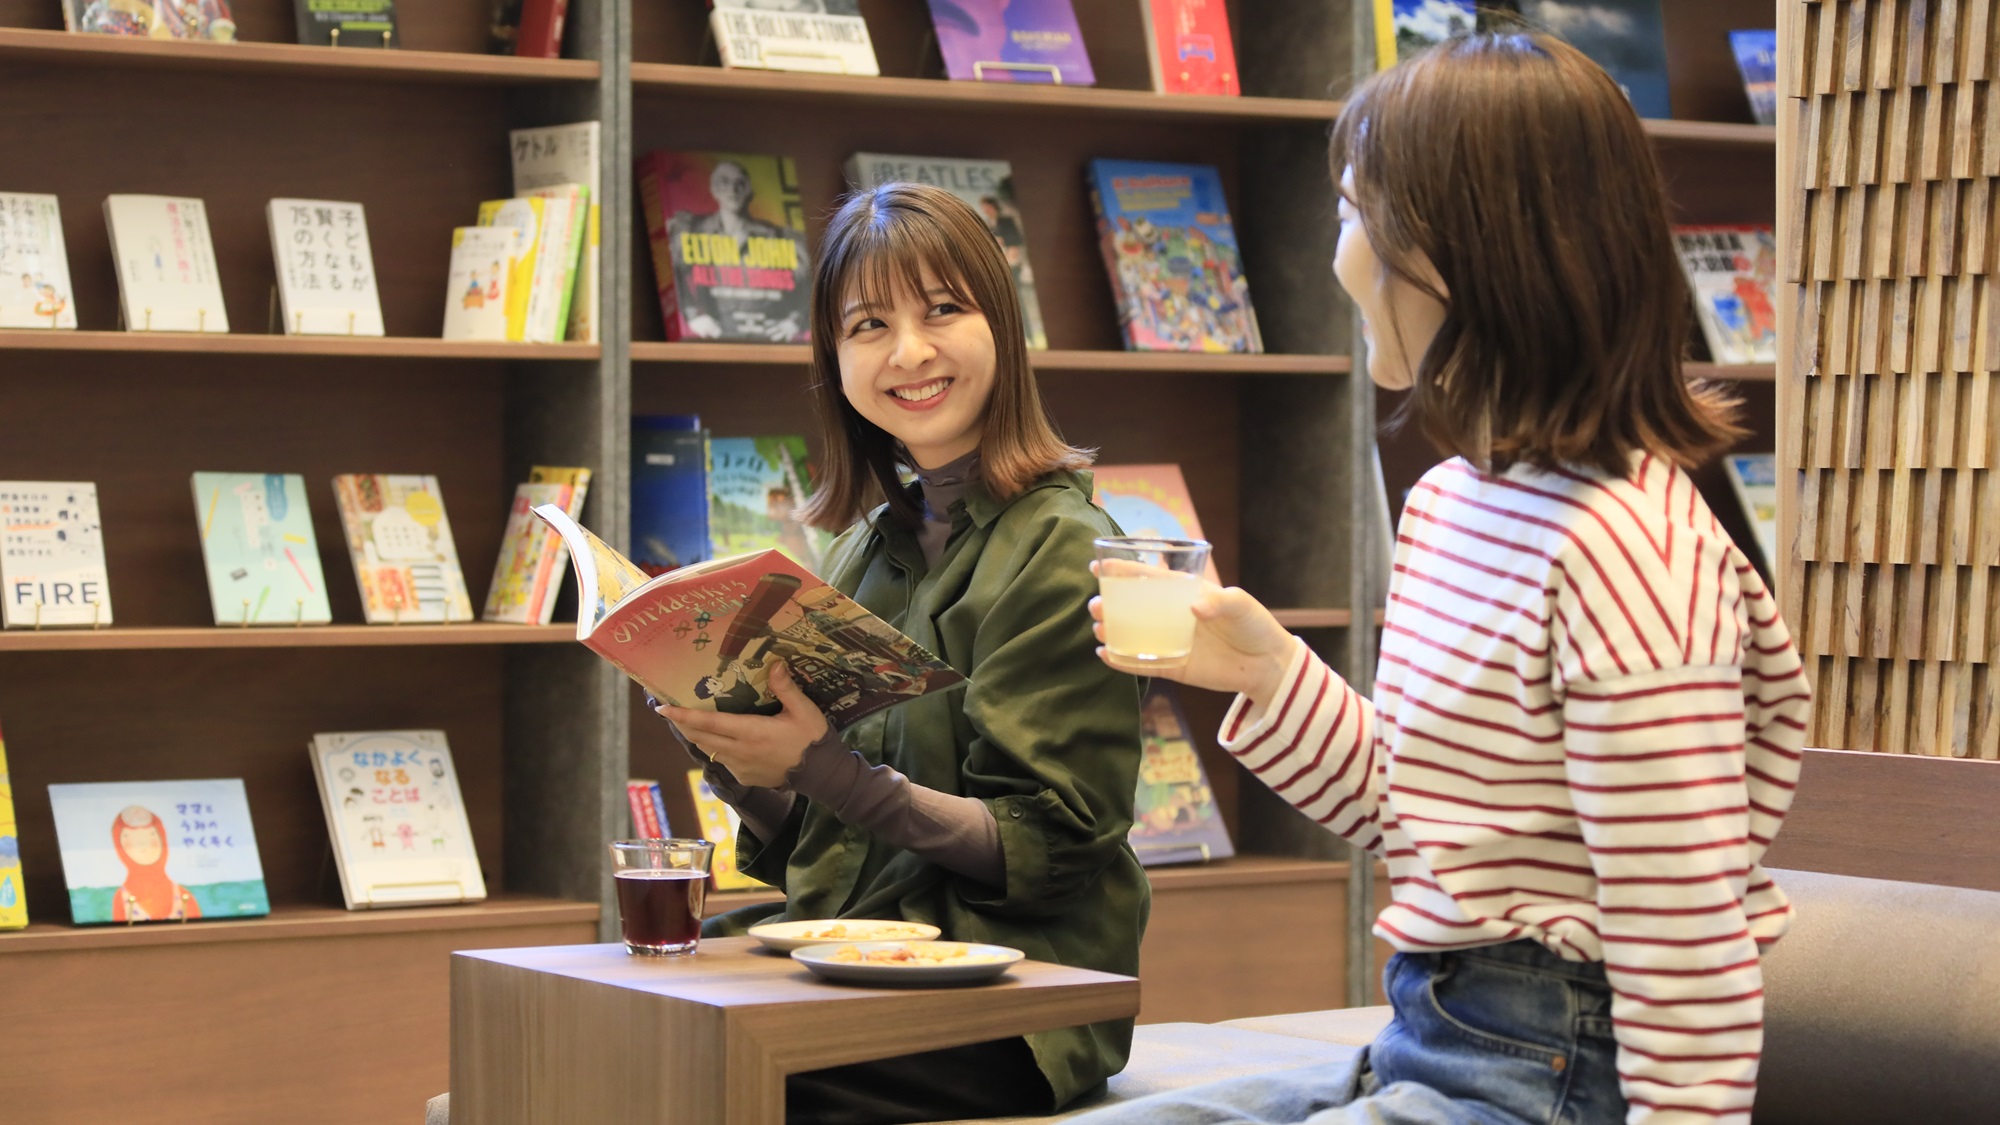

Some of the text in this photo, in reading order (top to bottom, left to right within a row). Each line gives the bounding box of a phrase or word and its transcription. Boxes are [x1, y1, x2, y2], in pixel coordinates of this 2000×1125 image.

[723, 12, 865, 44] THE ROLLING STONES
[730, 38, 762, 61] 1972
[514, 135, 560, 162] ケトル
[880, 162, 996, 189] BEATLES
[289, 206, 321, 291] 75の方法
[313, 207, 343, 291] 賢くなる
[337, 208, 369, 292] 子どもが
[680, 231, 799, 270] ELTON JOHN
[692, 265, 718, 287] ALL
[15, 582, 99, 605] FIRE
[352, 750, 425, 768] なかよく
[374, 768, 411, 785] なる
[371, 787, 421, 805] ことば
[175, 802, 215, 815] ママと
[180, 819, 219, 832] うみの
[182, 835, 236, 848] やくそく
